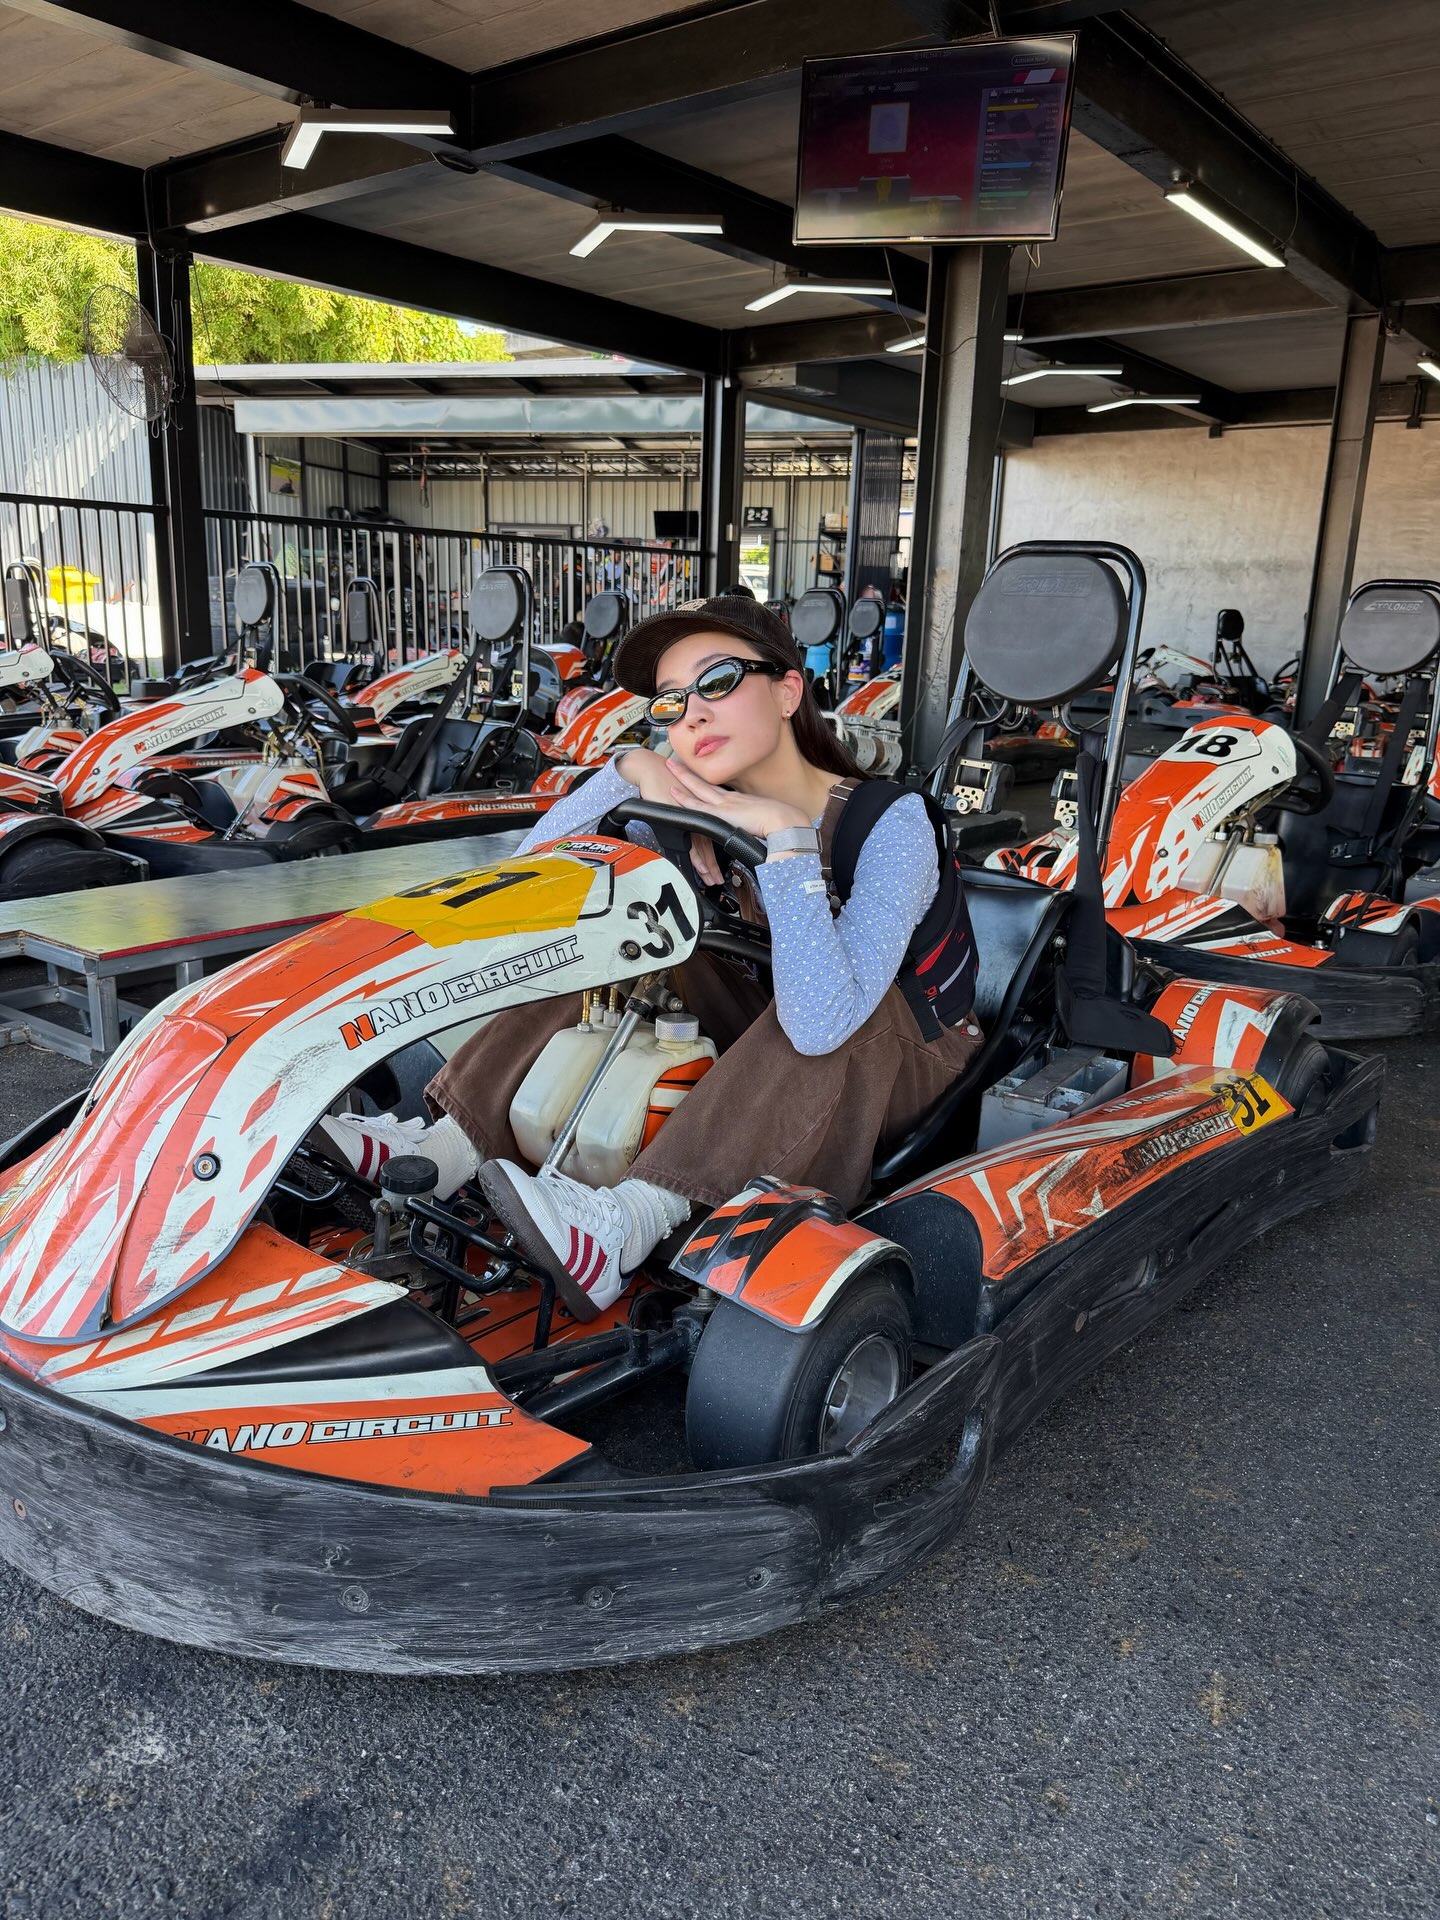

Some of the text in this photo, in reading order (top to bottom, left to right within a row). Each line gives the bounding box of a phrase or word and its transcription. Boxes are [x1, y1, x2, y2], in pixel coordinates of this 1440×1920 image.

[1174, 733, 1239, 758] 18
[626, 882, 697, 958] 31
[1210, 1074, 1271, 1128] 31
